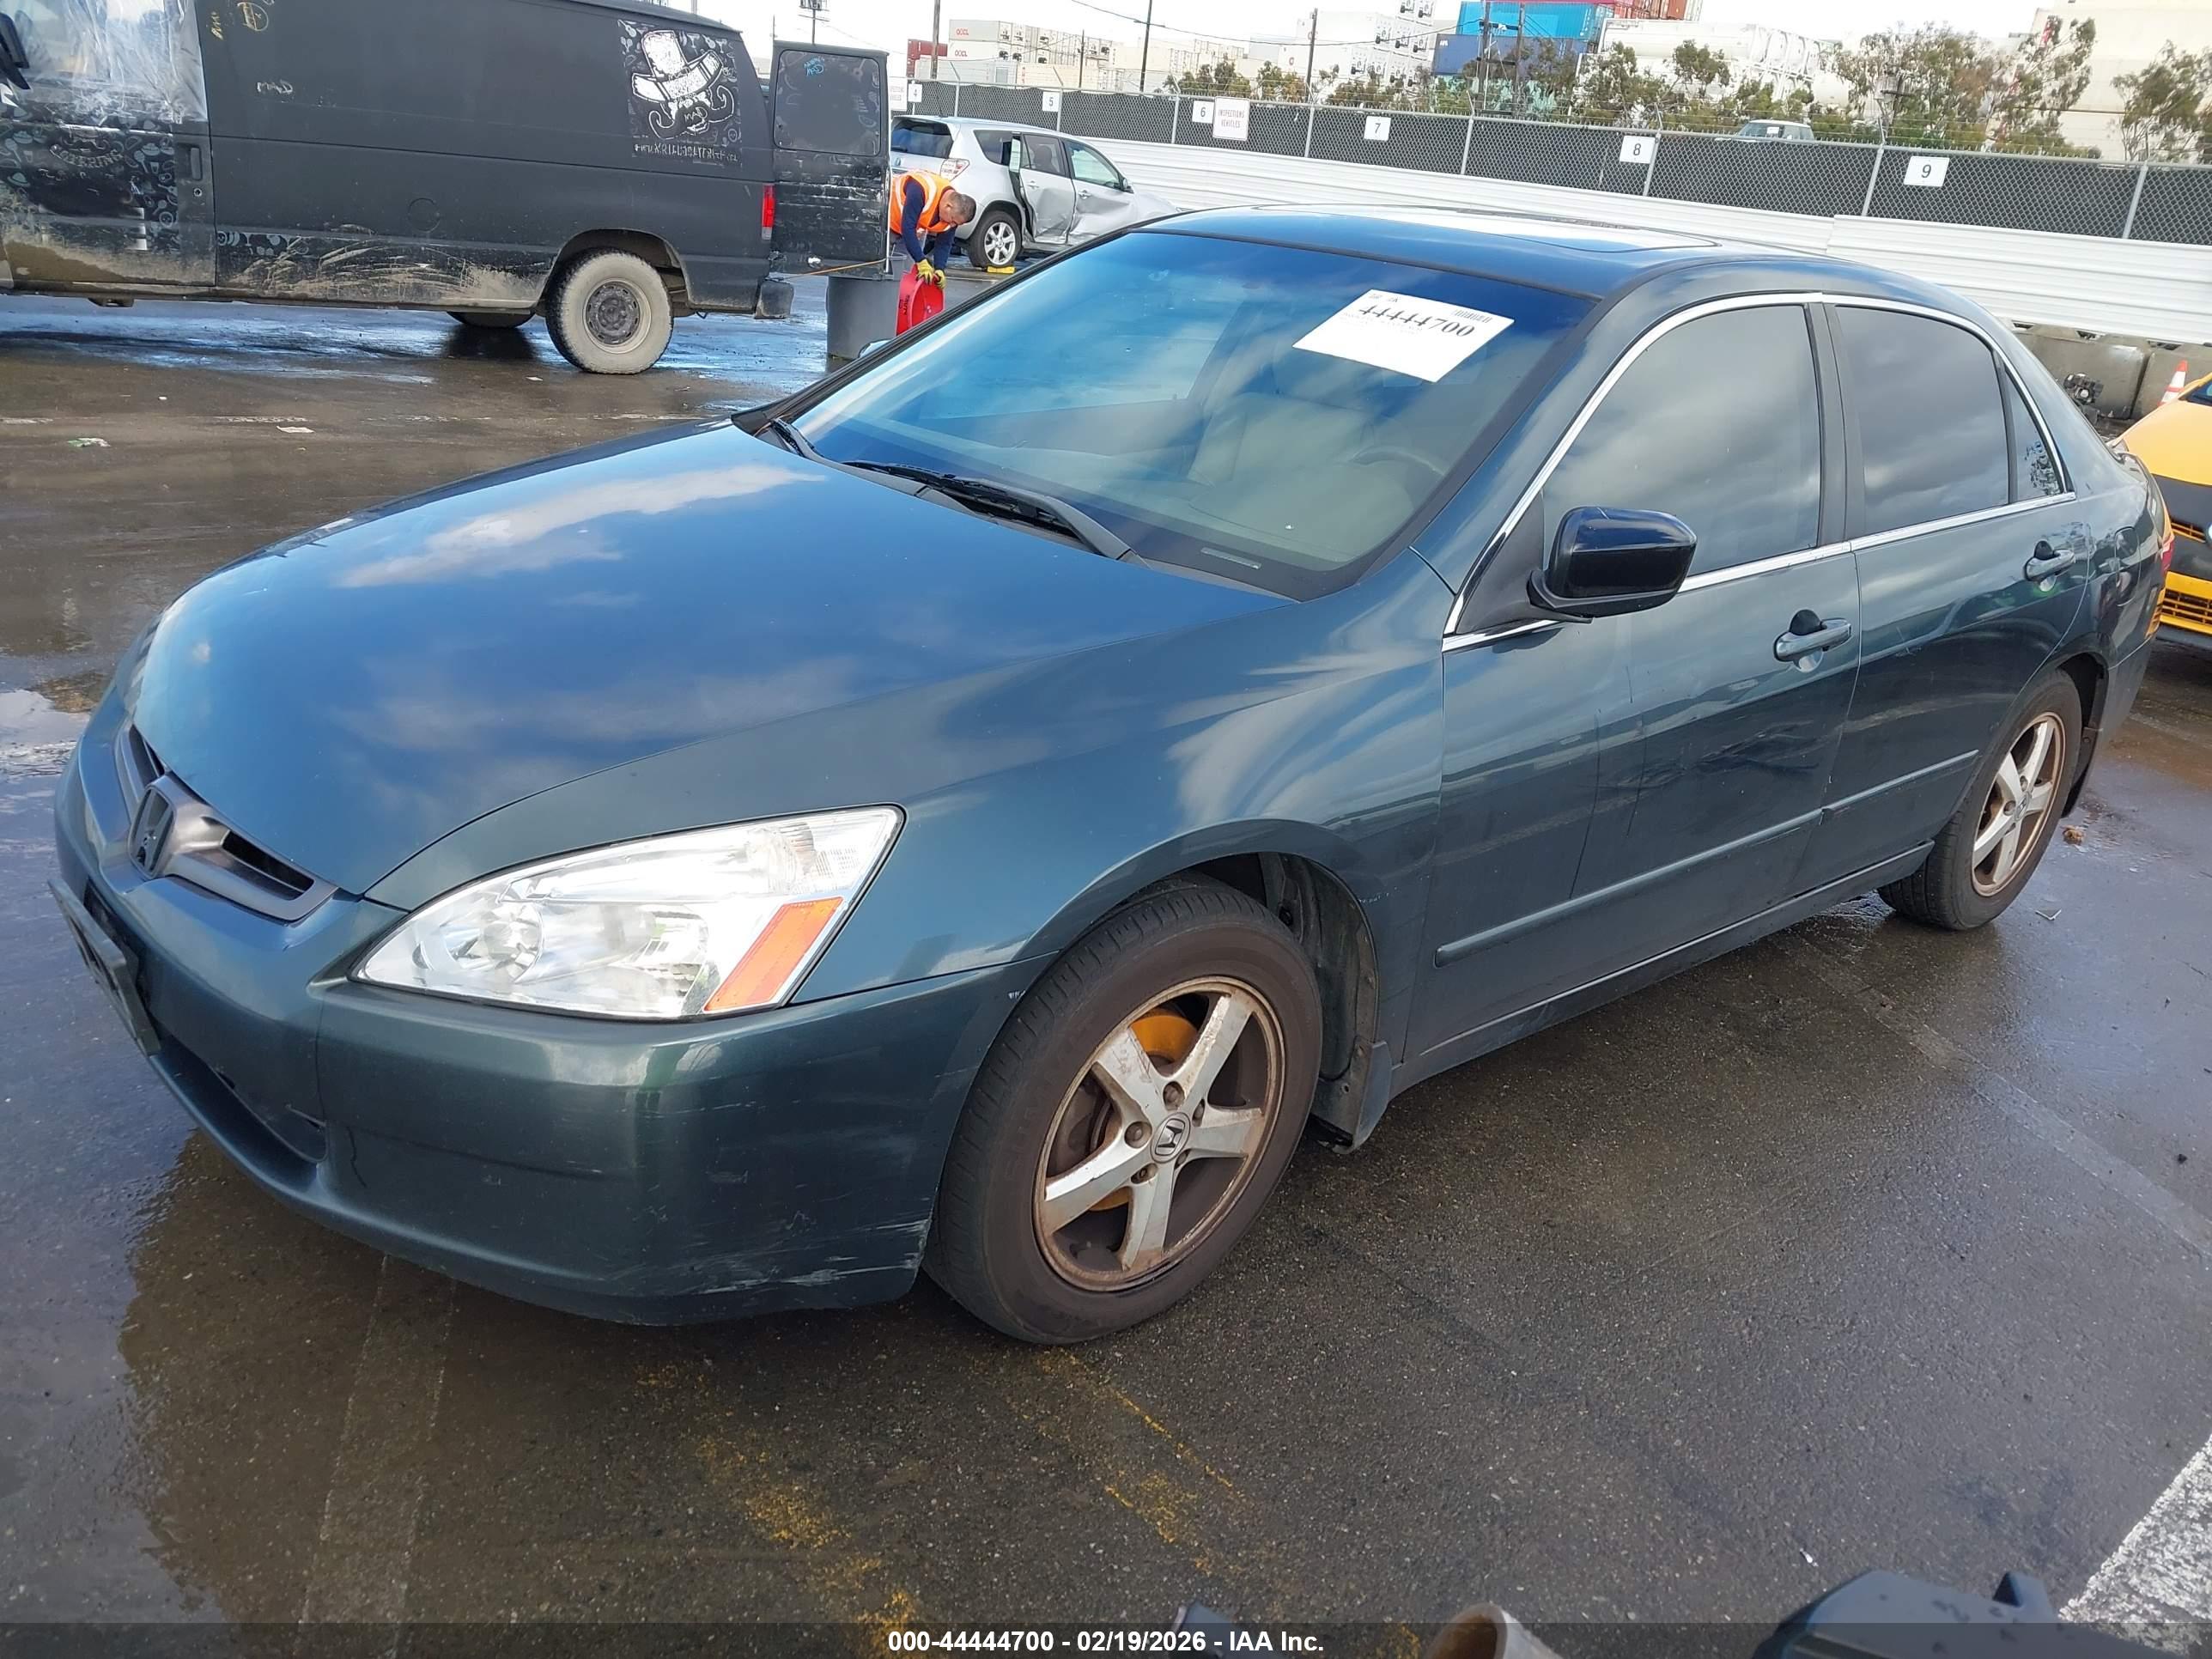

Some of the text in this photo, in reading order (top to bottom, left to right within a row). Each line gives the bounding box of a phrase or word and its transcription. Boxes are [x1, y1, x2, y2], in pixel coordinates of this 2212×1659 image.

[1048, 97, 1054, 106] 5
[1200, 106, 1206, 118] 6
[1374, 122, 1381, 134] 7
[1632, 143, 1642, 156] 8
[1920, 164, 1932, 179] 9
[1358, 304, 1475, 337] 44444700
